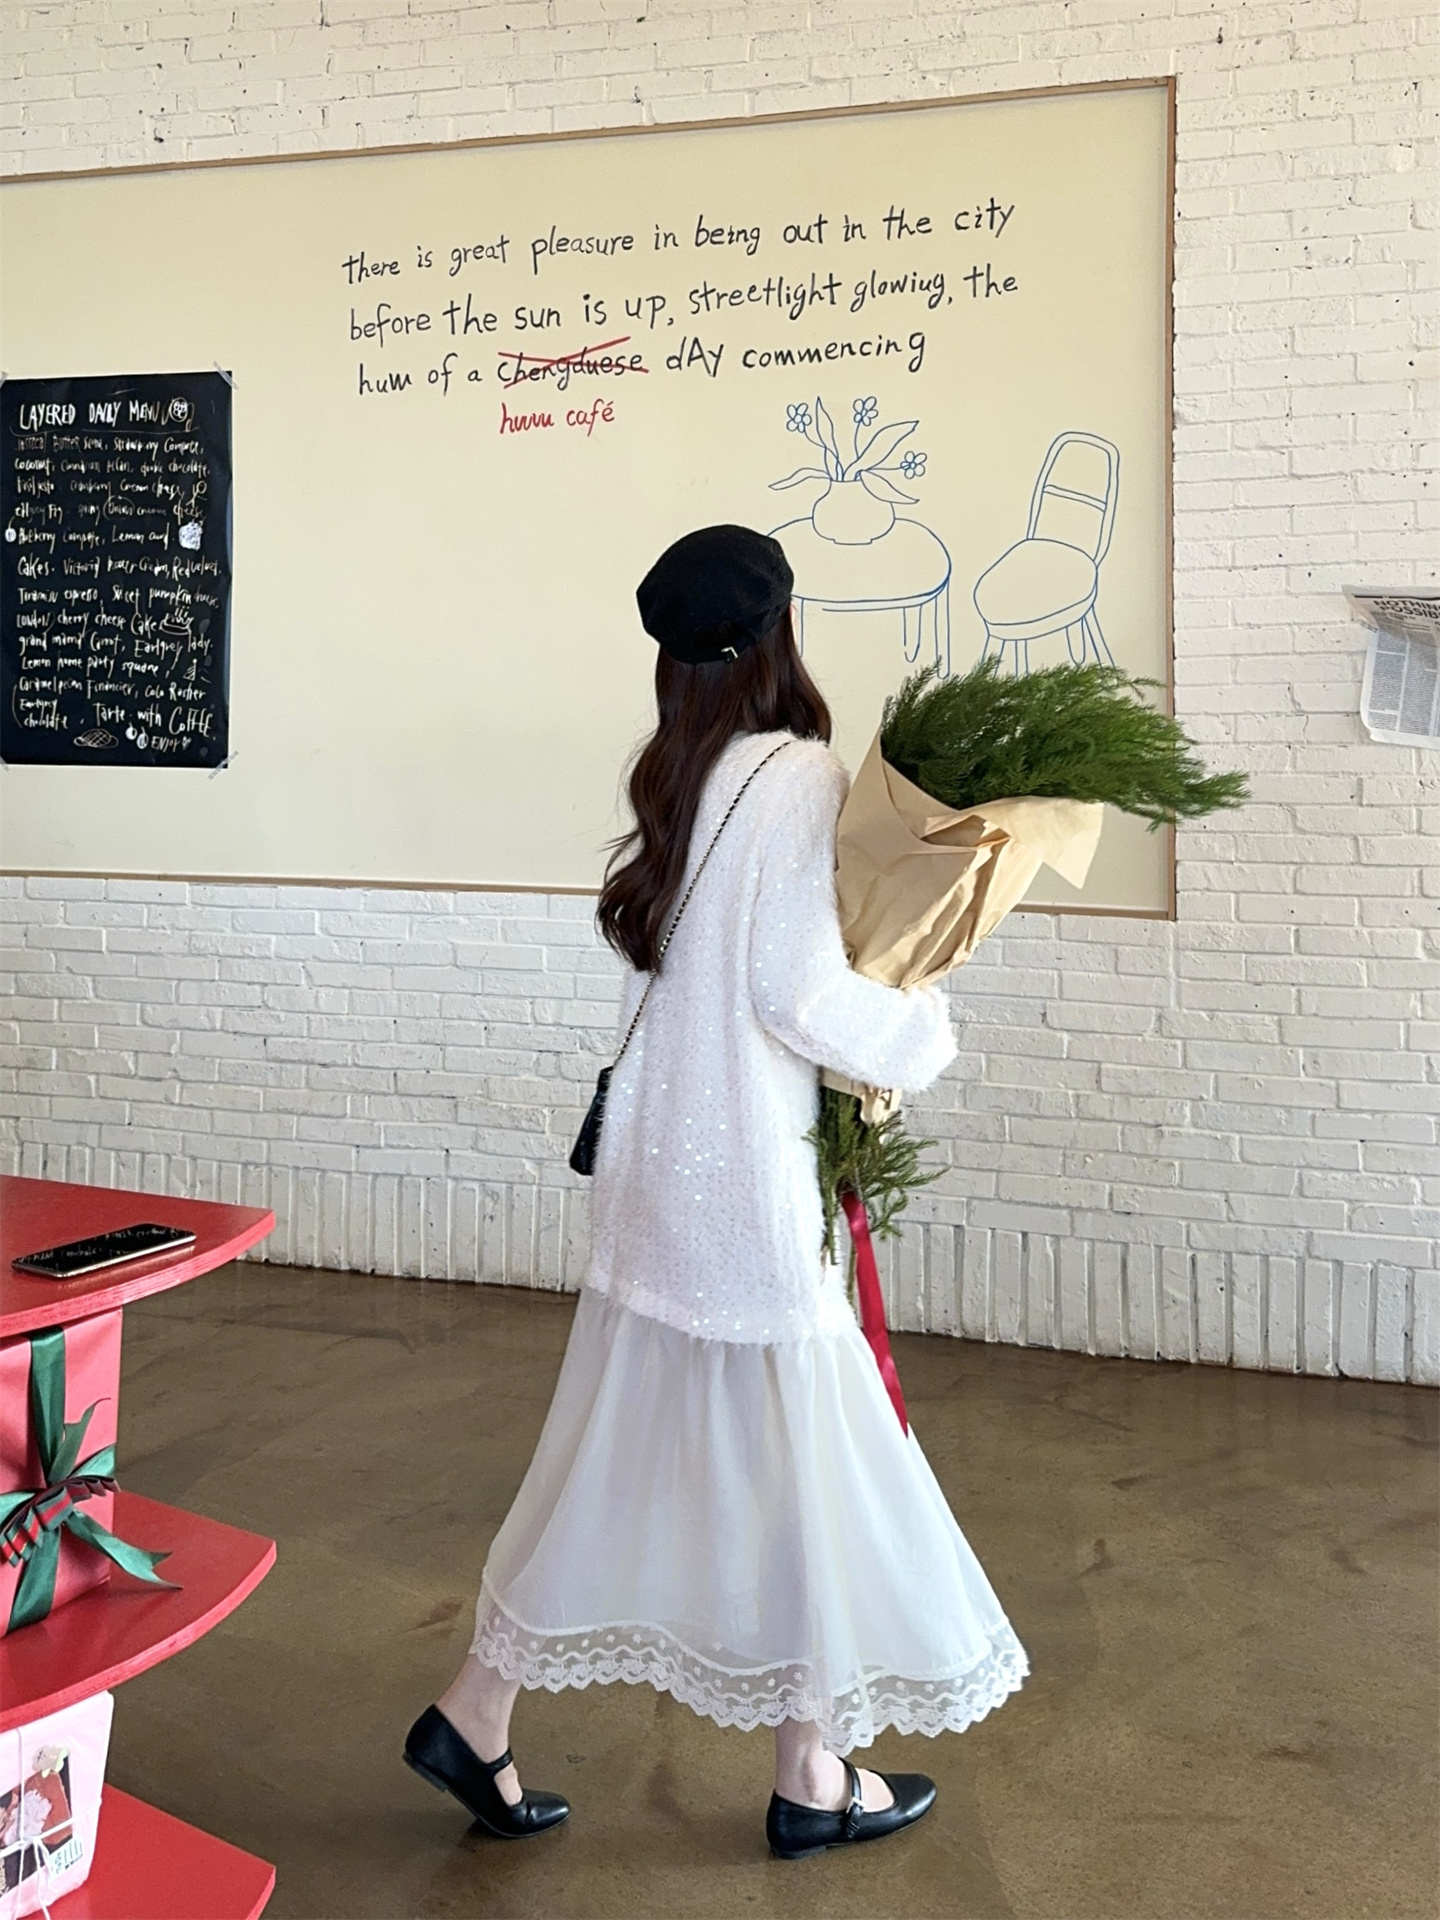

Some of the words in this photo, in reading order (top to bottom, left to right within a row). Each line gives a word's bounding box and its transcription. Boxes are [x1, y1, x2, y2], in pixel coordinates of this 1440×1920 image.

[342, 251, 401, 284] there
[416, 245, 433, 268] is
[449, 234, 510, 277] great
[531, 225, 634, 275] pleasure
[654, 224, 679, 250] in
[694, 214, 761, 256] being
[783, 213, 828, 244] out
[843, 214, 867, 243] in
[882, 205, 933, 241] the
[954, 197, 1015, 238] city
[350, 303, 431, 348] before
[442, 293, 498, 335] the
[514, 306, 562, 329] sun
[582, 294, 607, 325] is
[690, 273, 842, 321] streetlight
[963, 263, 1018, 299] the
[427, 352, 459, 396] of
[467, 369, 483, 383] a
[742, 332, 926, 373] commencing
[20, 402, 77, 432] LAYERED
[88, 401, 123, 428] DAILY
[566, 398, 615, 437] café
[1373, 600, 1440, 612] NOTHIN
[137, 703, 162, 728] with
